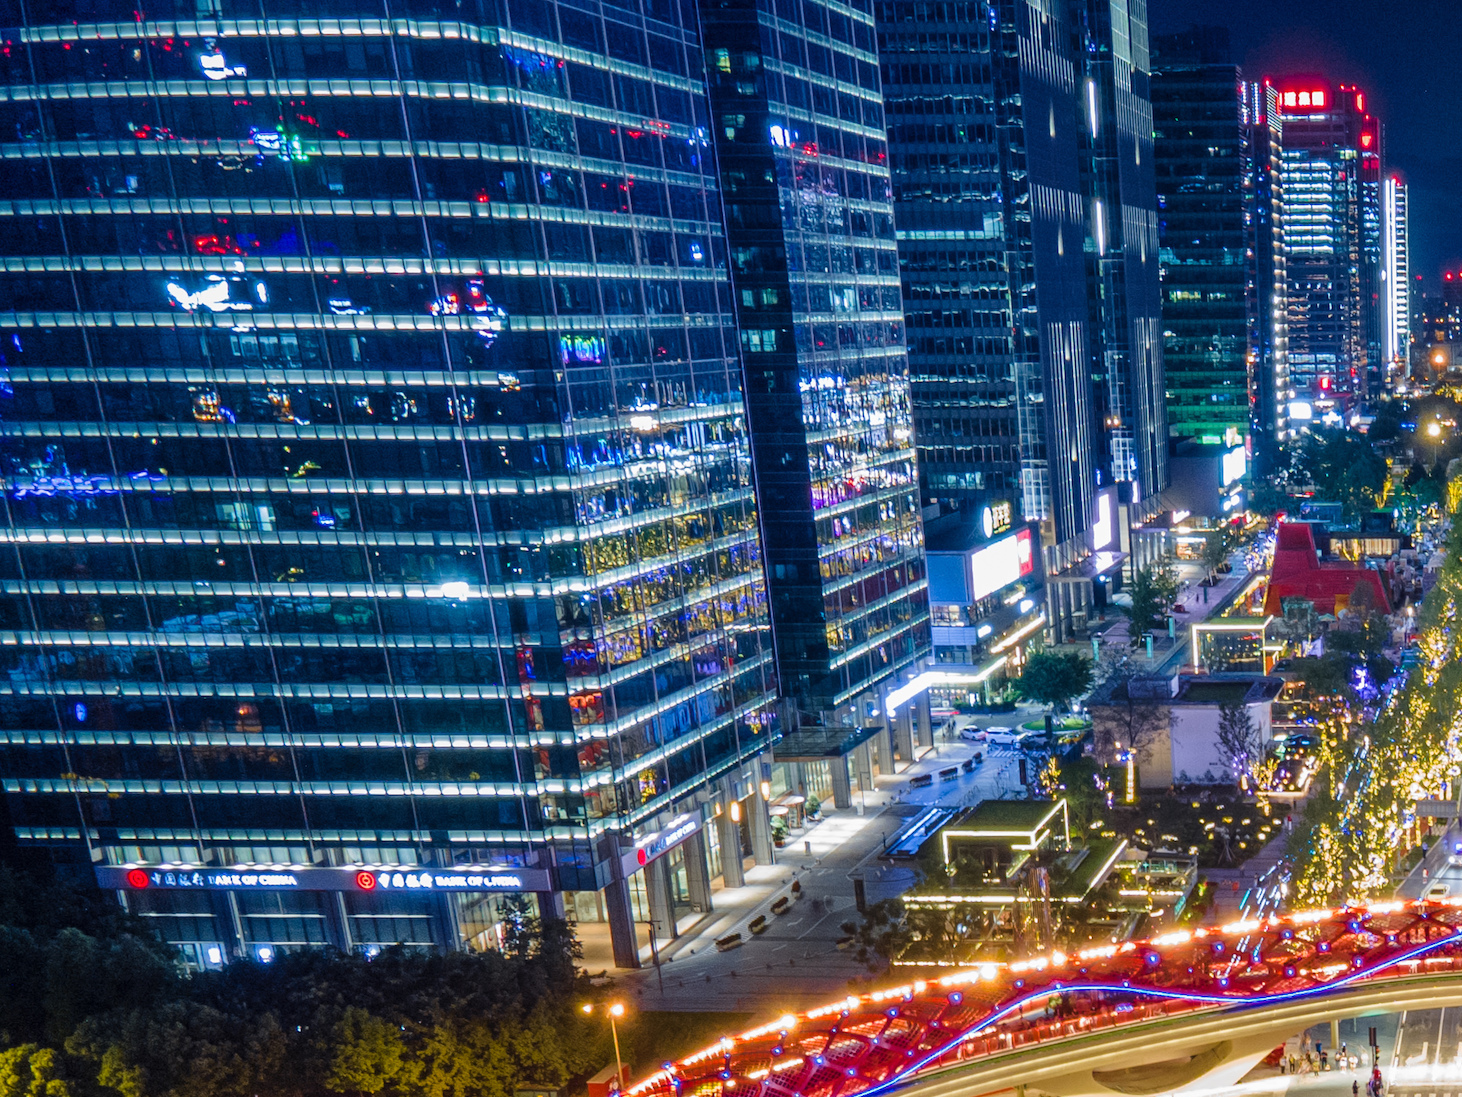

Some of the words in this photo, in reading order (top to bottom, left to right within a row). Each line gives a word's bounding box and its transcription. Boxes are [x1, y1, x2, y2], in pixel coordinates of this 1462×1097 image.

[241, 875, 258, 886] OF
[258, 875, 298, 886] CHINA
[467, 876, 484, 887] OF
